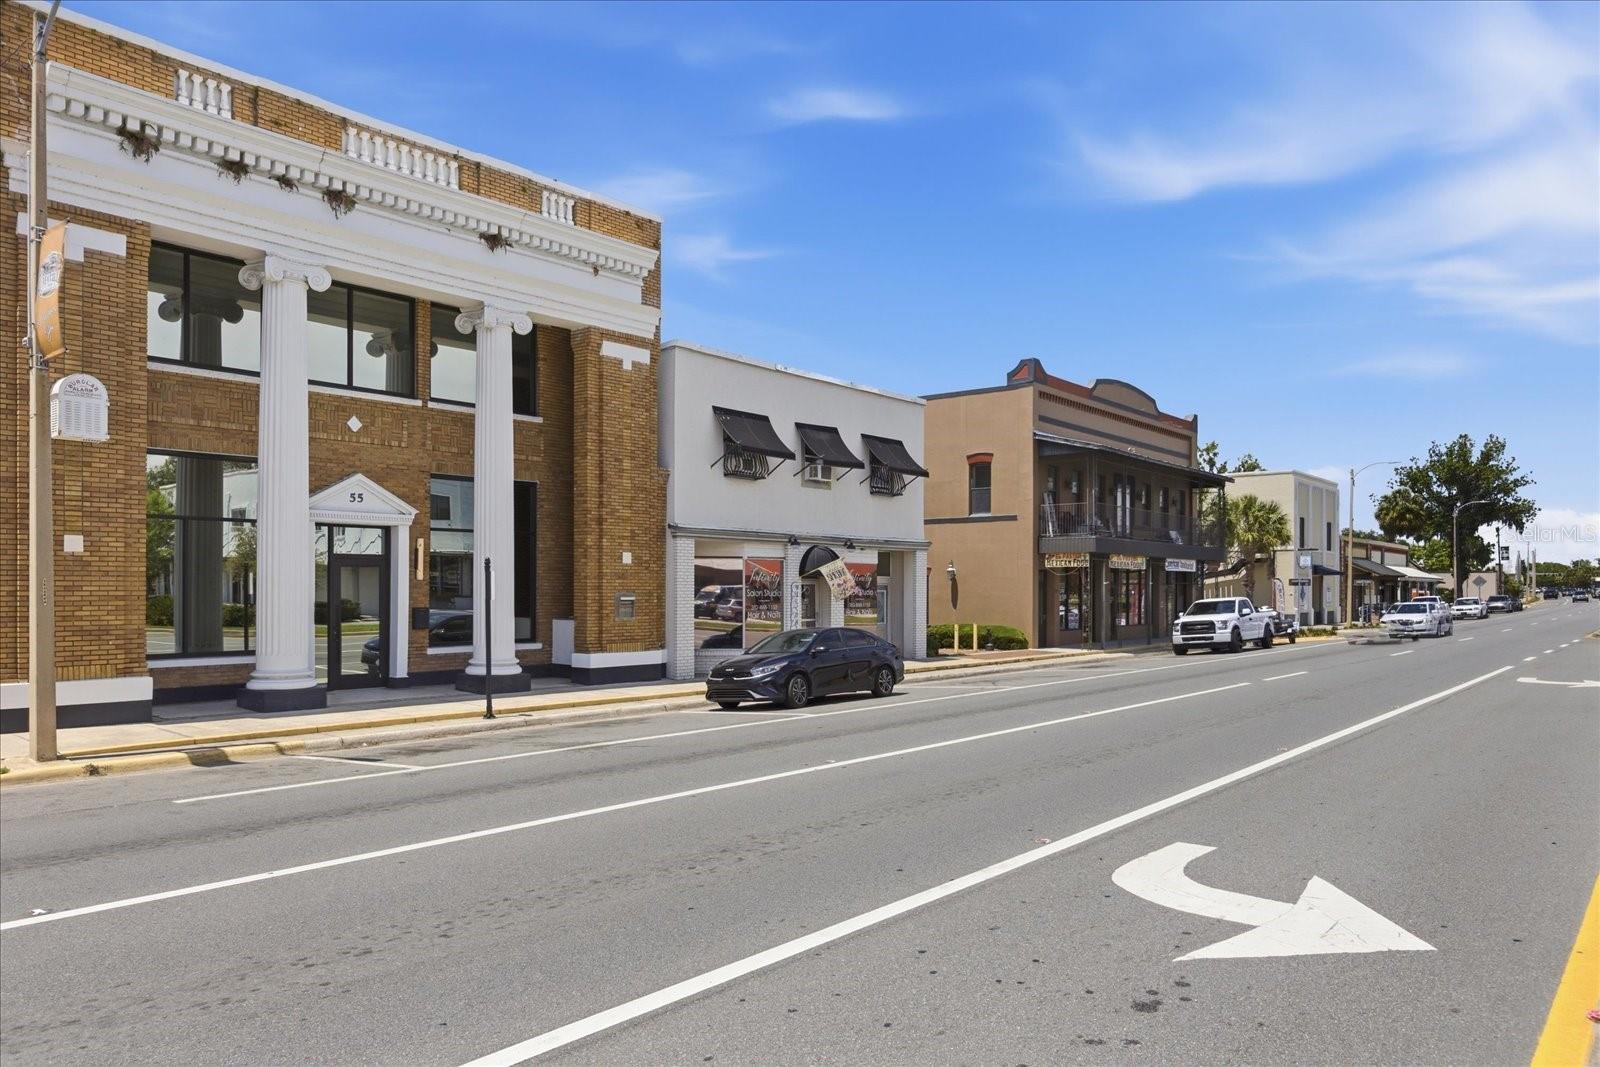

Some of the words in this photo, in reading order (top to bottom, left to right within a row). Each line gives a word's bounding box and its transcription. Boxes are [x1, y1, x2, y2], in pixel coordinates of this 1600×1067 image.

[67, 379, 99, 392] BURGLAR
[349, 492, 364, 503] 55
[1047, 559, 1072, 567] MEXICAN
[1073, 558, 1089, 567] FOOD
